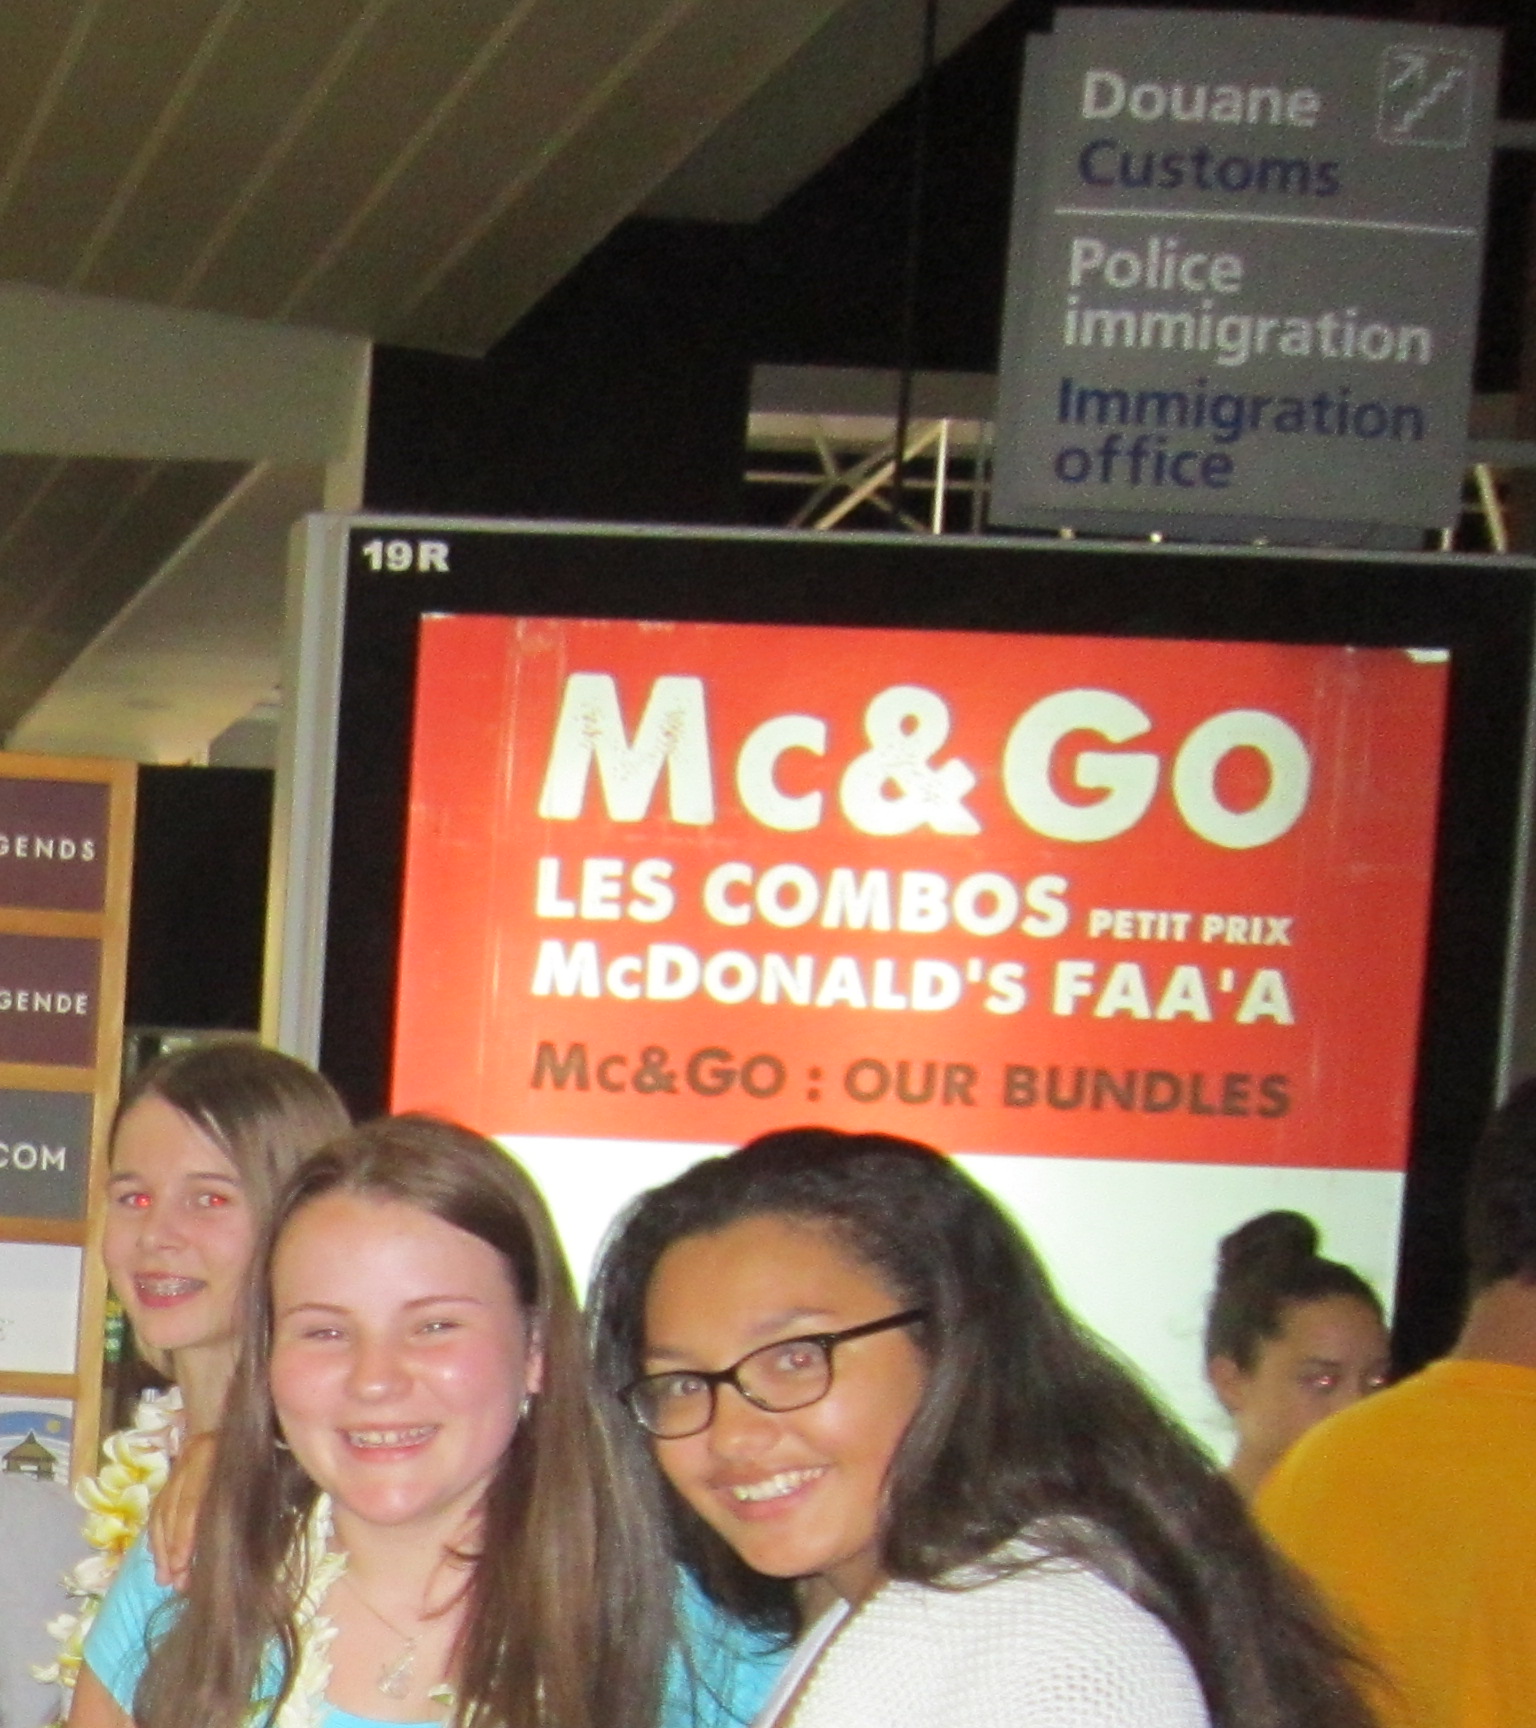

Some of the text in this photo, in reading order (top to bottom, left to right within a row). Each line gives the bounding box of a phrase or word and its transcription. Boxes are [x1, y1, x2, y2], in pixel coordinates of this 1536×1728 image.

[1082, 70, 1322, 128] Douane
[1078, 139, 1341, 197] Customs
[1069, 236, 1244, 293] Police
[1063, 295, 1432, 366] immigration
[1057, 378, 1426, 443] Immigration
[1054, 435, 1235, 489] office
[362, 538, 450, 573] 19R
[533, 855, 1294, 947] LES COMBOS PETIT PRIX
[531, 939, 1295, 1026] McDONALD'S FAA'A
[844, 1057, 978, 1106] OUR
[1002, 1063, 1292, 1119] BUNDLES
